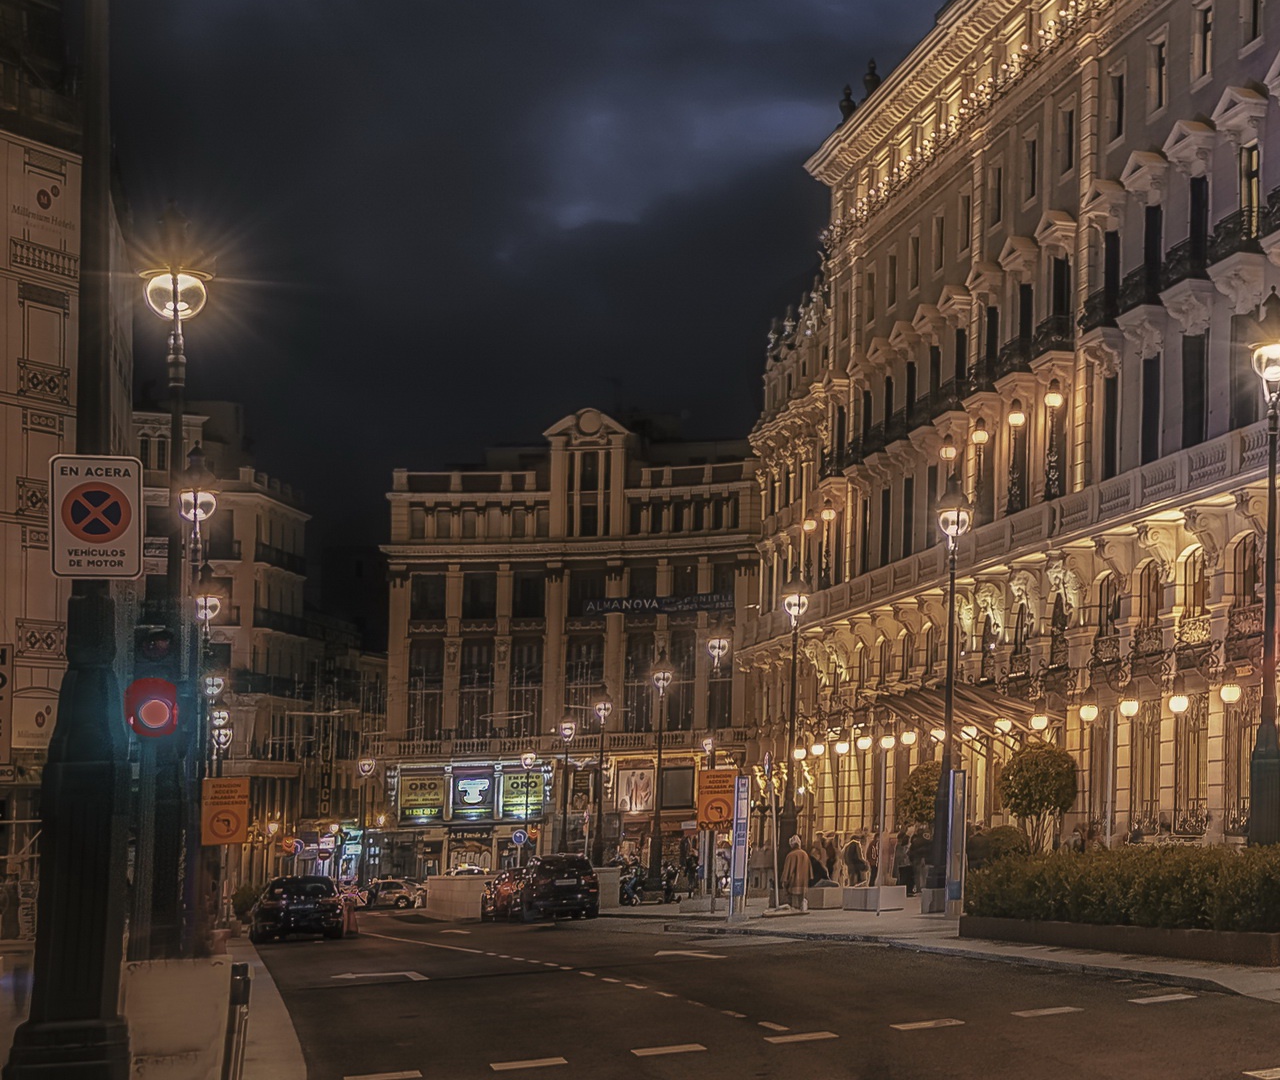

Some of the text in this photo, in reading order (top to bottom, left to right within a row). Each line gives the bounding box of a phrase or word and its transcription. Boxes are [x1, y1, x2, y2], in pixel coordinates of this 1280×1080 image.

[60, 466, 132, 478] EN ACERA
[68, 547, 126, 557] VEHÍCULOS
[68, 560, 124, 568] DE MOTOR
[409, 782, 438, 791] ORO
[510, 780, 538, 789] ORO
